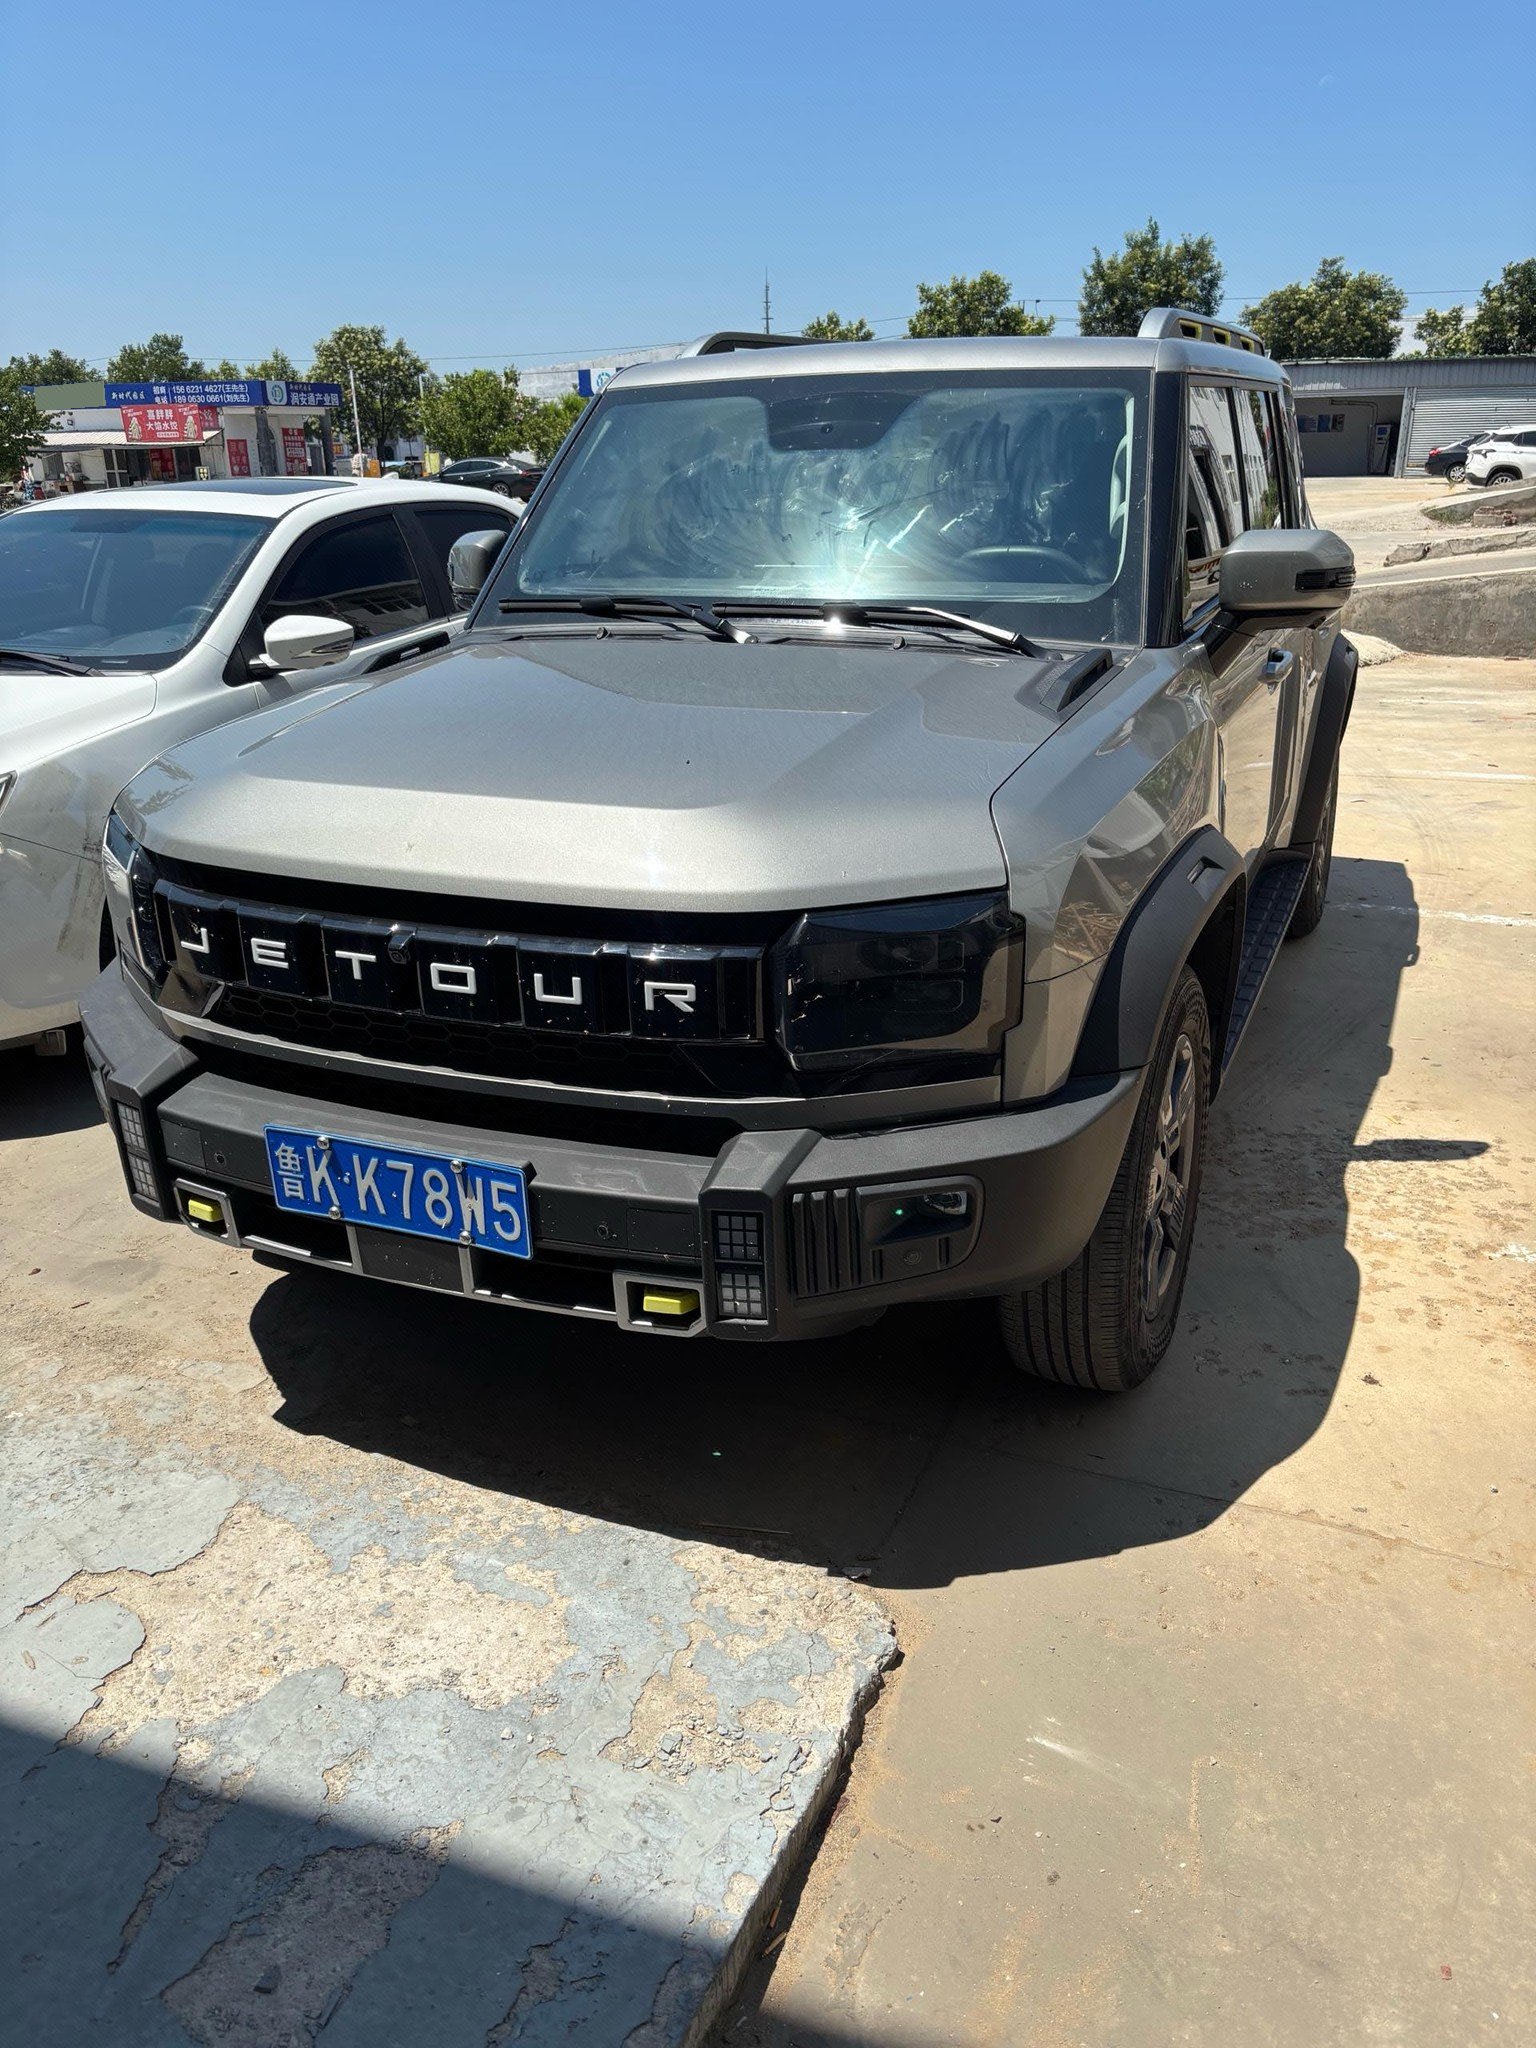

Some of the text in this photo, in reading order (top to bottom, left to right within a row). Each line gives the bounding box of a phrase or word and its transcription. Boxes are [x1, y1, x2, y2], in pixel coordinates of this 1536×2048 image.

[153, 386, 166, 395] 招商
[172, 386, 185, 394] 156
[186, 385, 203, 393] 6231
[155, 396, 168, 404] 电话
[290, 392, 339, 405] 润安通产业园
[145, 420, 179, 431] 大馅水饺
[180, 927, 697, 1013] JETOUR
